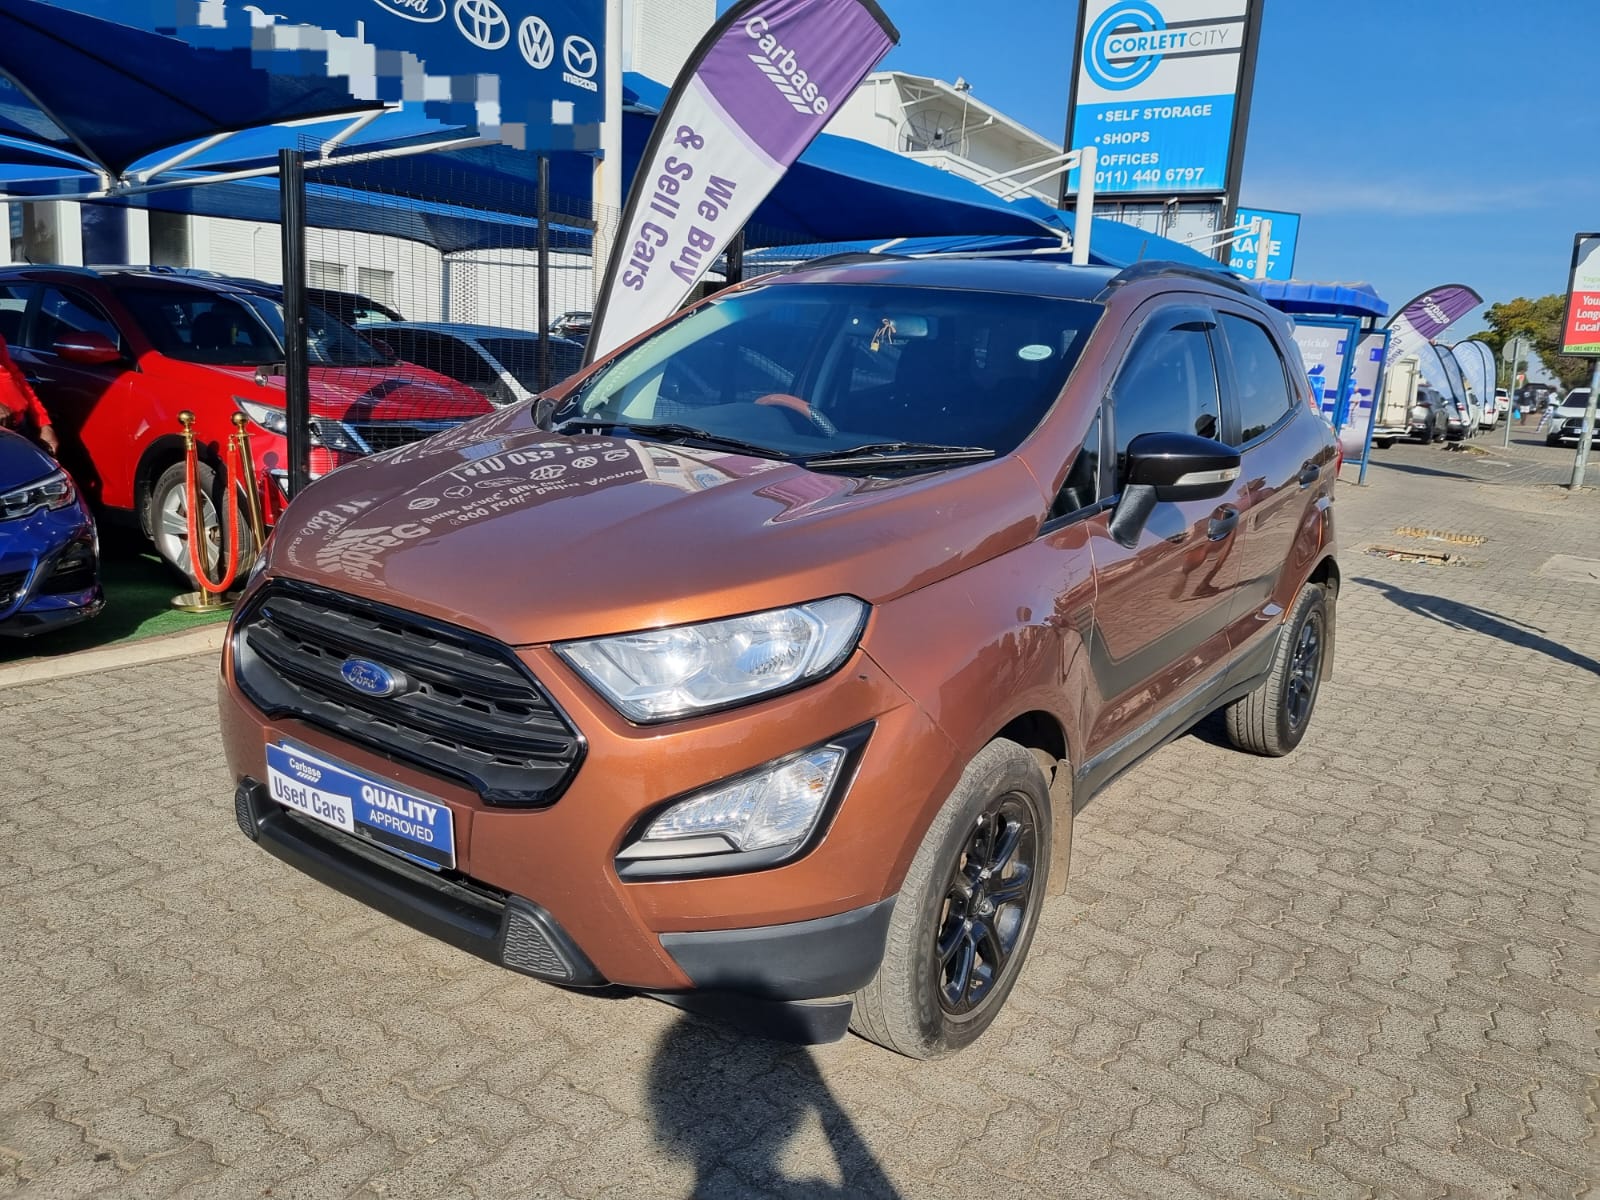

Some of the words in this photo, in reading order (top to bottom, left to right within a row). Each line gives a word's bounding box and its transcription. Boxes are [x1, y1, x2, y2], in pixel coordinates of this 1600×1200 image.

[745, 16, 829, 115] Carbase
[1105, 109, 1140, 122] SELF
[1143, 104, 1213, 120] STORAGE
[673, 125, 705, 150] &
[1102, 131, 1150, 145] SHOPS
[1100, 152, 1159, 166] OFFICES
[650, 156, 694, 220] Sell
[1095, 171, 1128, 185] 011)
[1132, 169, 1161, 182] 440
[1165, 167, 1205, 181] 6797
[697, 174, 737, 222] We
[622, 221, 668, 291] Cars
[670, 225, 716, 285] Buy
[1583, 295, 1600, 305] You
[289, 758, 322, 779] Carbase
[273, 775, 308, 809] Used
[311, 791, 346, 824] Cars
[361, 785, 438, 825] QUALITY
[369, 810, 434, 842] APPROVED
